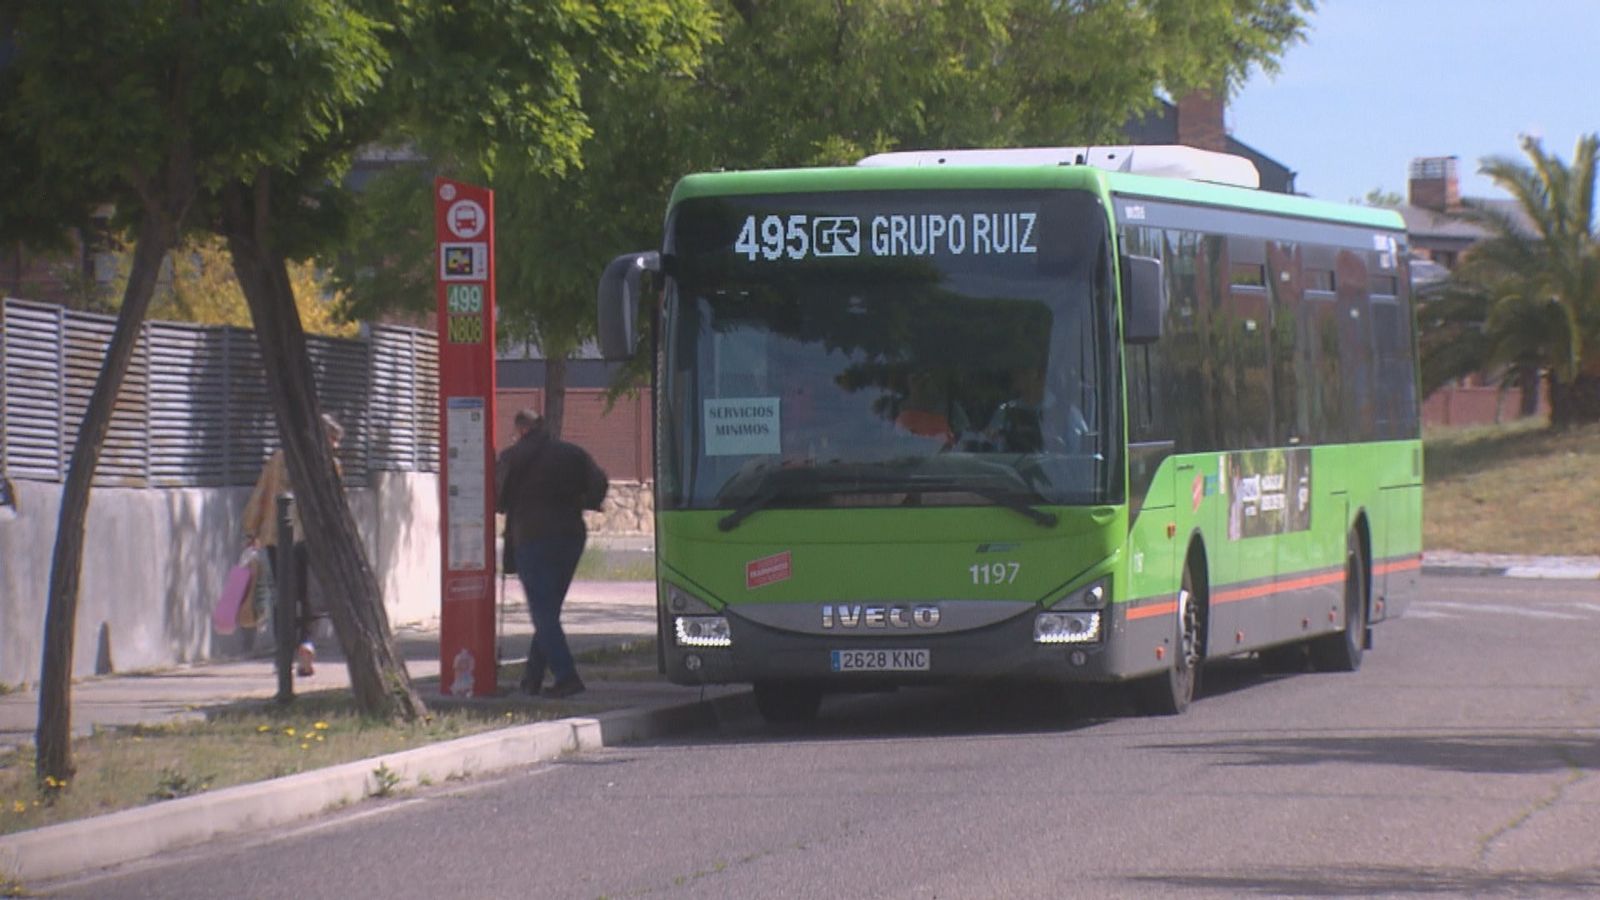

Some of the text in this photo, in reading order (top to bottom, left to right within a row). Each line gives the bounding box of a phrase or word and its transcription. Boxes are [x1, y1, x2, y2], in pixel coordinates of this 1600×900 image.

[735, 214, 809, 261] 495
[871, 214, 966, 256] GRUPO
[973, 212, 1037, 254] RUIZ
[449, 285, 482, 312] 499
[709, 406, 774, 419] SERVICIOS
[715, 423, 770, 436] MINIMOS
[969, 562, 1021, 584] 1197
[821, 604, 942, 629] IVECO
[842, 651, 926, 668] 2628 KNC
